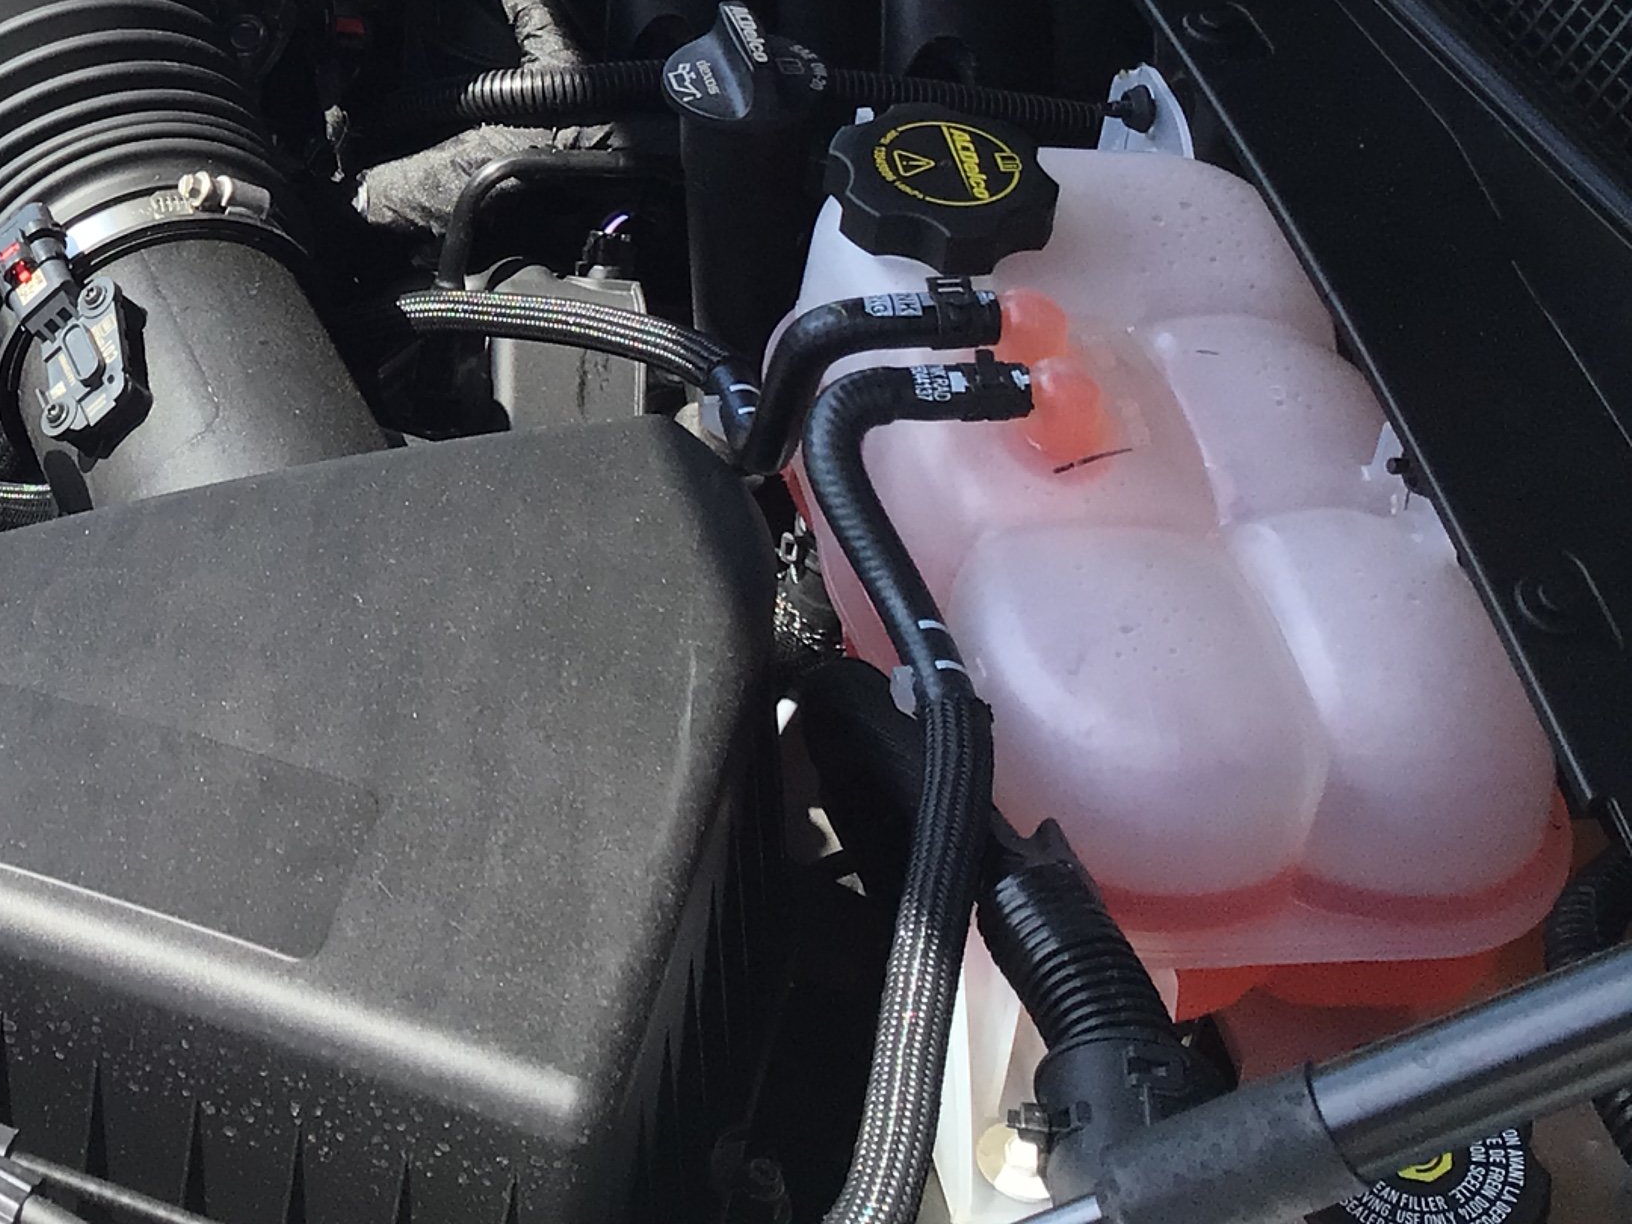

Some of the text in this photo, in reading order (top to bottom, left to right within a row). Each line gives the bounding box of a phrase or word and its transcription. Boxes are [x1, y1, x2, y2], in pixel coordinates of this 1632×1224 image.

[729, 5, 768, 63] ACDelco
[695, 59, 721, 95] dexos
[949, 127, 990, 200] ACDelco
[1502, 1128, 1522, 1146] ON
[1489, 1149, 1506, 1164] DE
[1506, 1148, 1525, 1187] AVANT
[1372, 1180, 1448, 1212] EAN FILLER
[1448, 1164, 1486, 1204] SCELLE
[1500, 1185, 1521, 1203] LA
[1396, 1209, 1421, 1224] USE
[1456, 1196, 1490, 1220] DOT4
